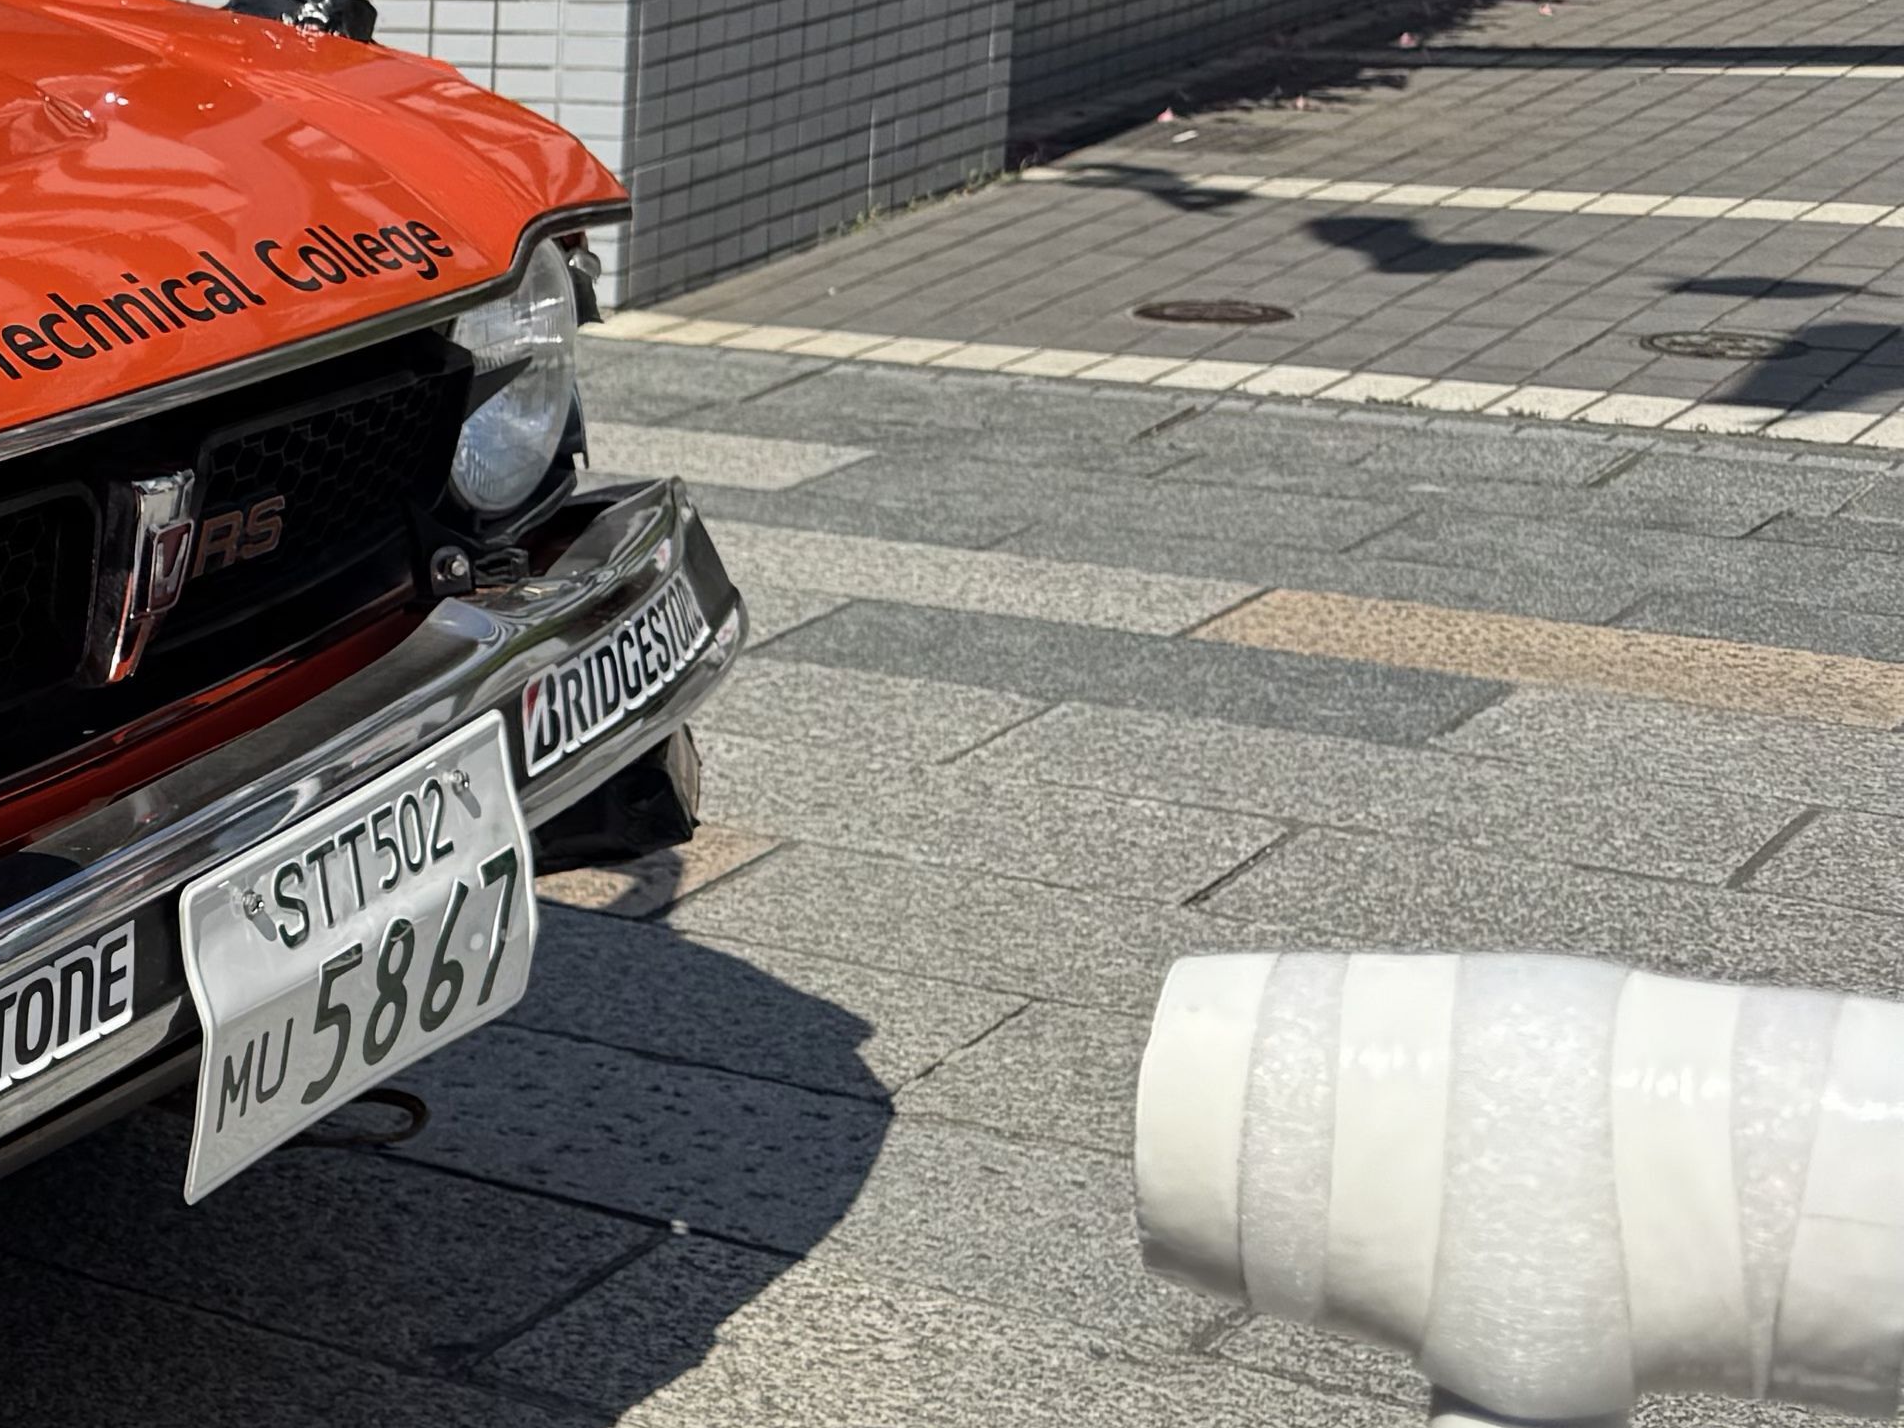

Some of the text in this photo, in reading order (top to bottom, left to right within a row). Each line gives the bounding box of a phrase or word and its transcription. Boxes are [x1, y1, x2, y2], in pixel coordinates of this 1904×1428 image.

[255, 215, 453, 292] College
[192, 495, 286, 578] RS
[273, 778, 455, 950] STT502
[217, 846, 517, 1134] MU 5867
